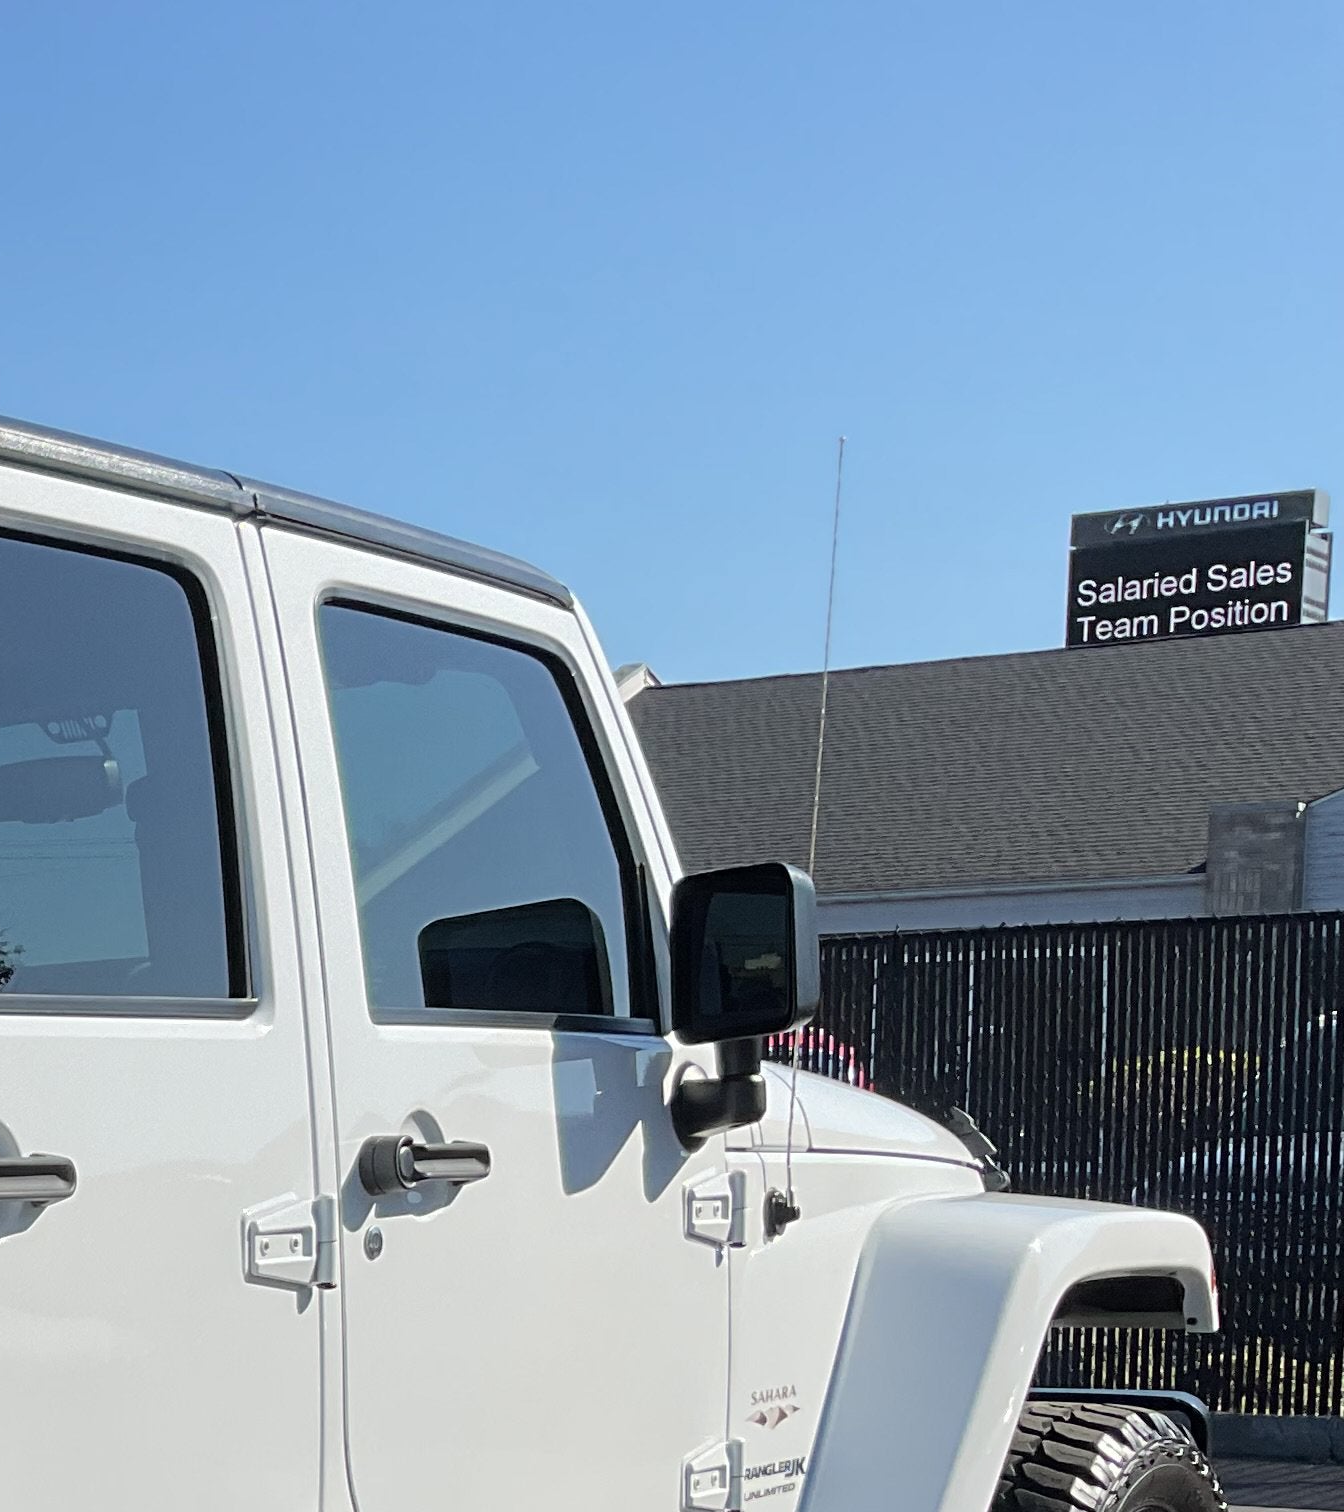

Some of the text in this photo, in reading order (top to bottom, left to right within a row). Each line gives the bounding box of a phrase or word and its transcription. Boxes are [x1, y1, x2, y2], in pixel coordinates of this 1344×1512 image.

[1157, 500, 1279, 530] HYUNDAI
[1076, 560, 1293, 606] Salaried Sales
[1076, 599, 1289, 642] Team Position
[750, 1384, 797, 1406] SAHARA
[743, 1460, 792, 1480] RANGLER
[744, 1482, 796, 1501] UNLIMITED
